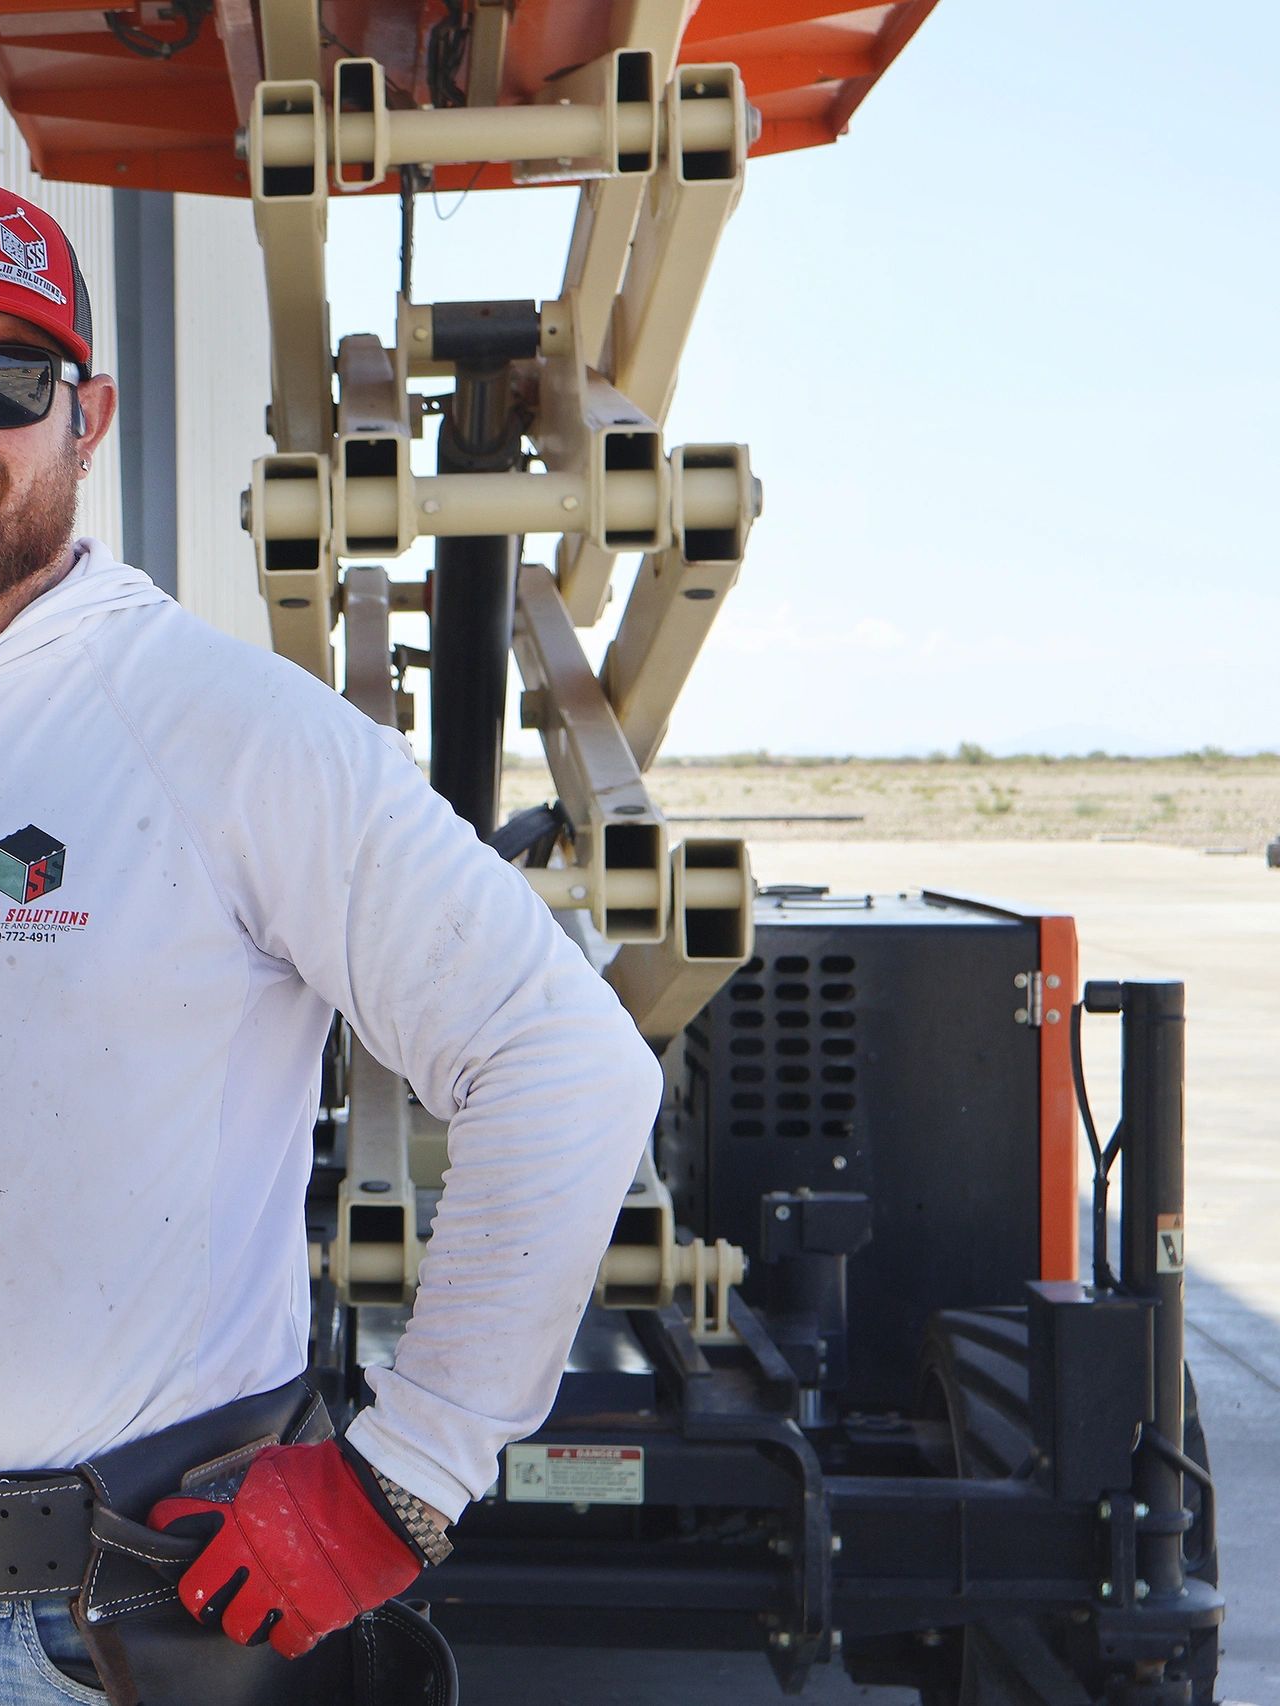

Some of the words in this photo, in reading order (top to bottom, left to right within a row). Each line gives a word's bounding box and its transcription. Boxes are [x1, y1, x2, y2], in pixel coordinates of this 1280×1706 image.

[16, 268, 60, 297] SOLUTIONS
[6, 908, 89, 926] SOLUTIONS
[11, 922, 29, 930] AND
[31, 923, 71, 932] ROOFING
